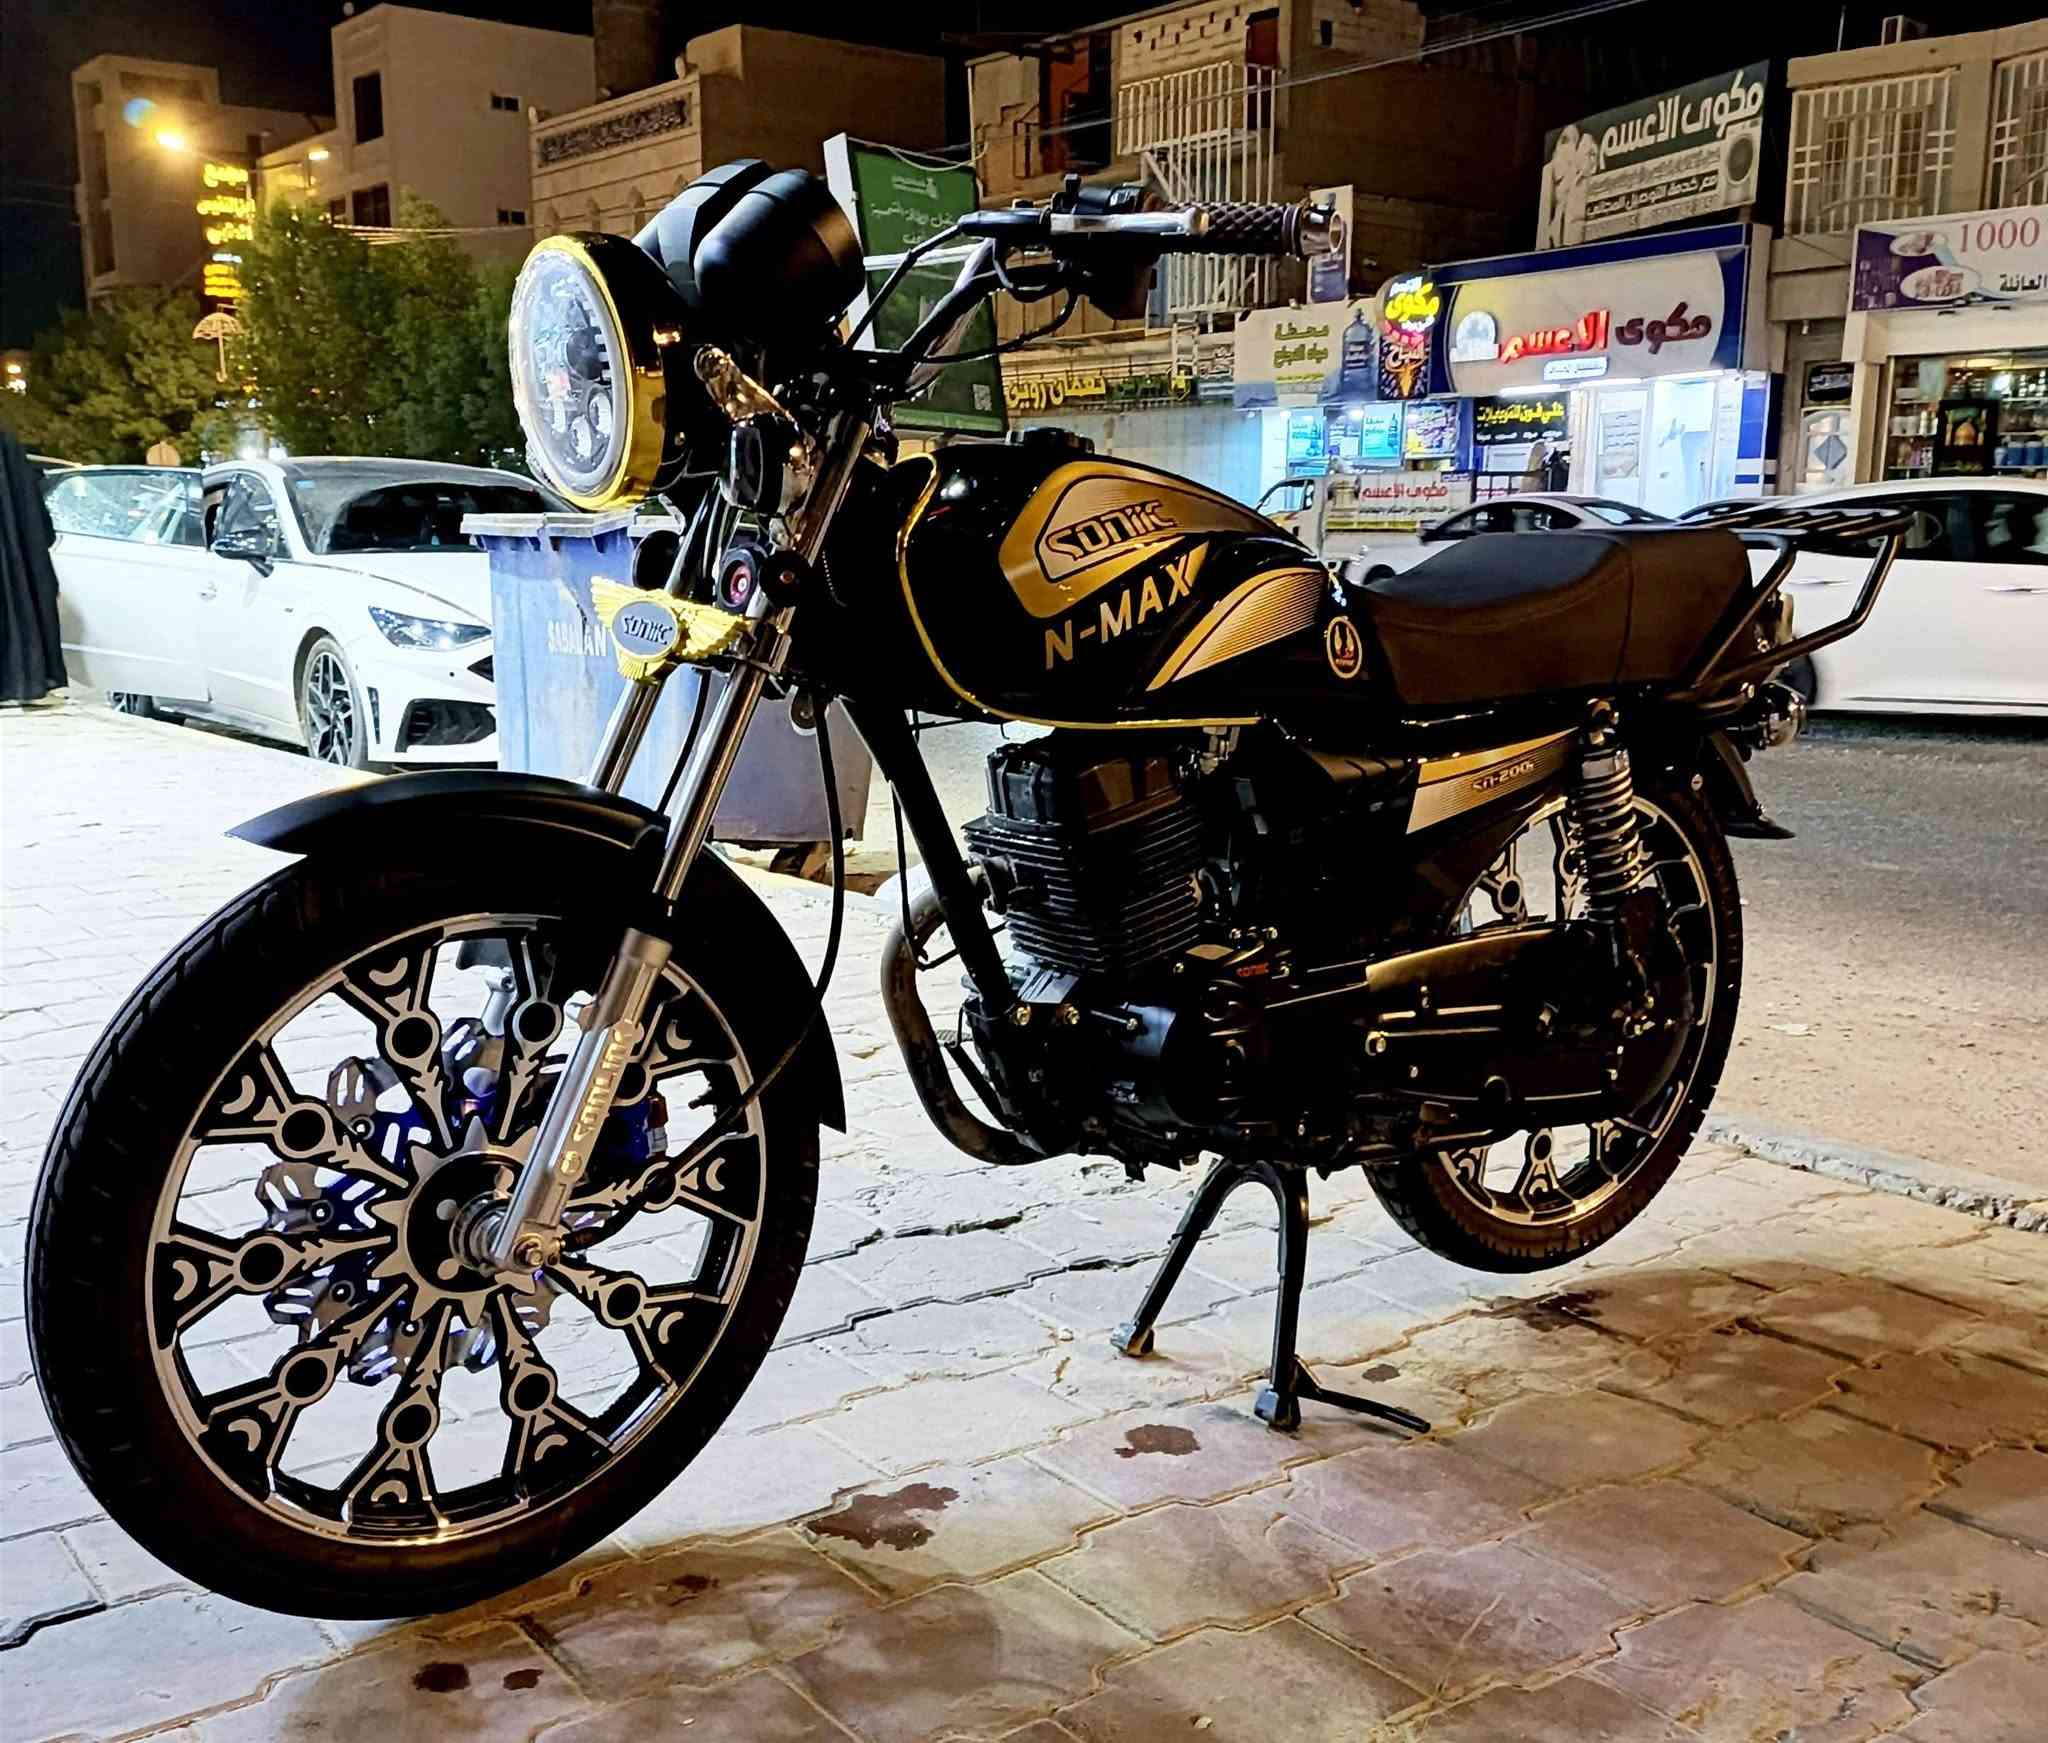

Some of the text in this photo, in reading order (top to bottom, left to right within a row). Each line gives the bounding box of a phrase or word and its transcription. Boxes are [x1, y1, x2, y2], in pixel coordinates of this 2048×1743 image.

[1960, 216, 2041, 254] 1000
[1615, 301, 1713, 355] مكوى
[1045, 553, 1191, 671] N-MAX
